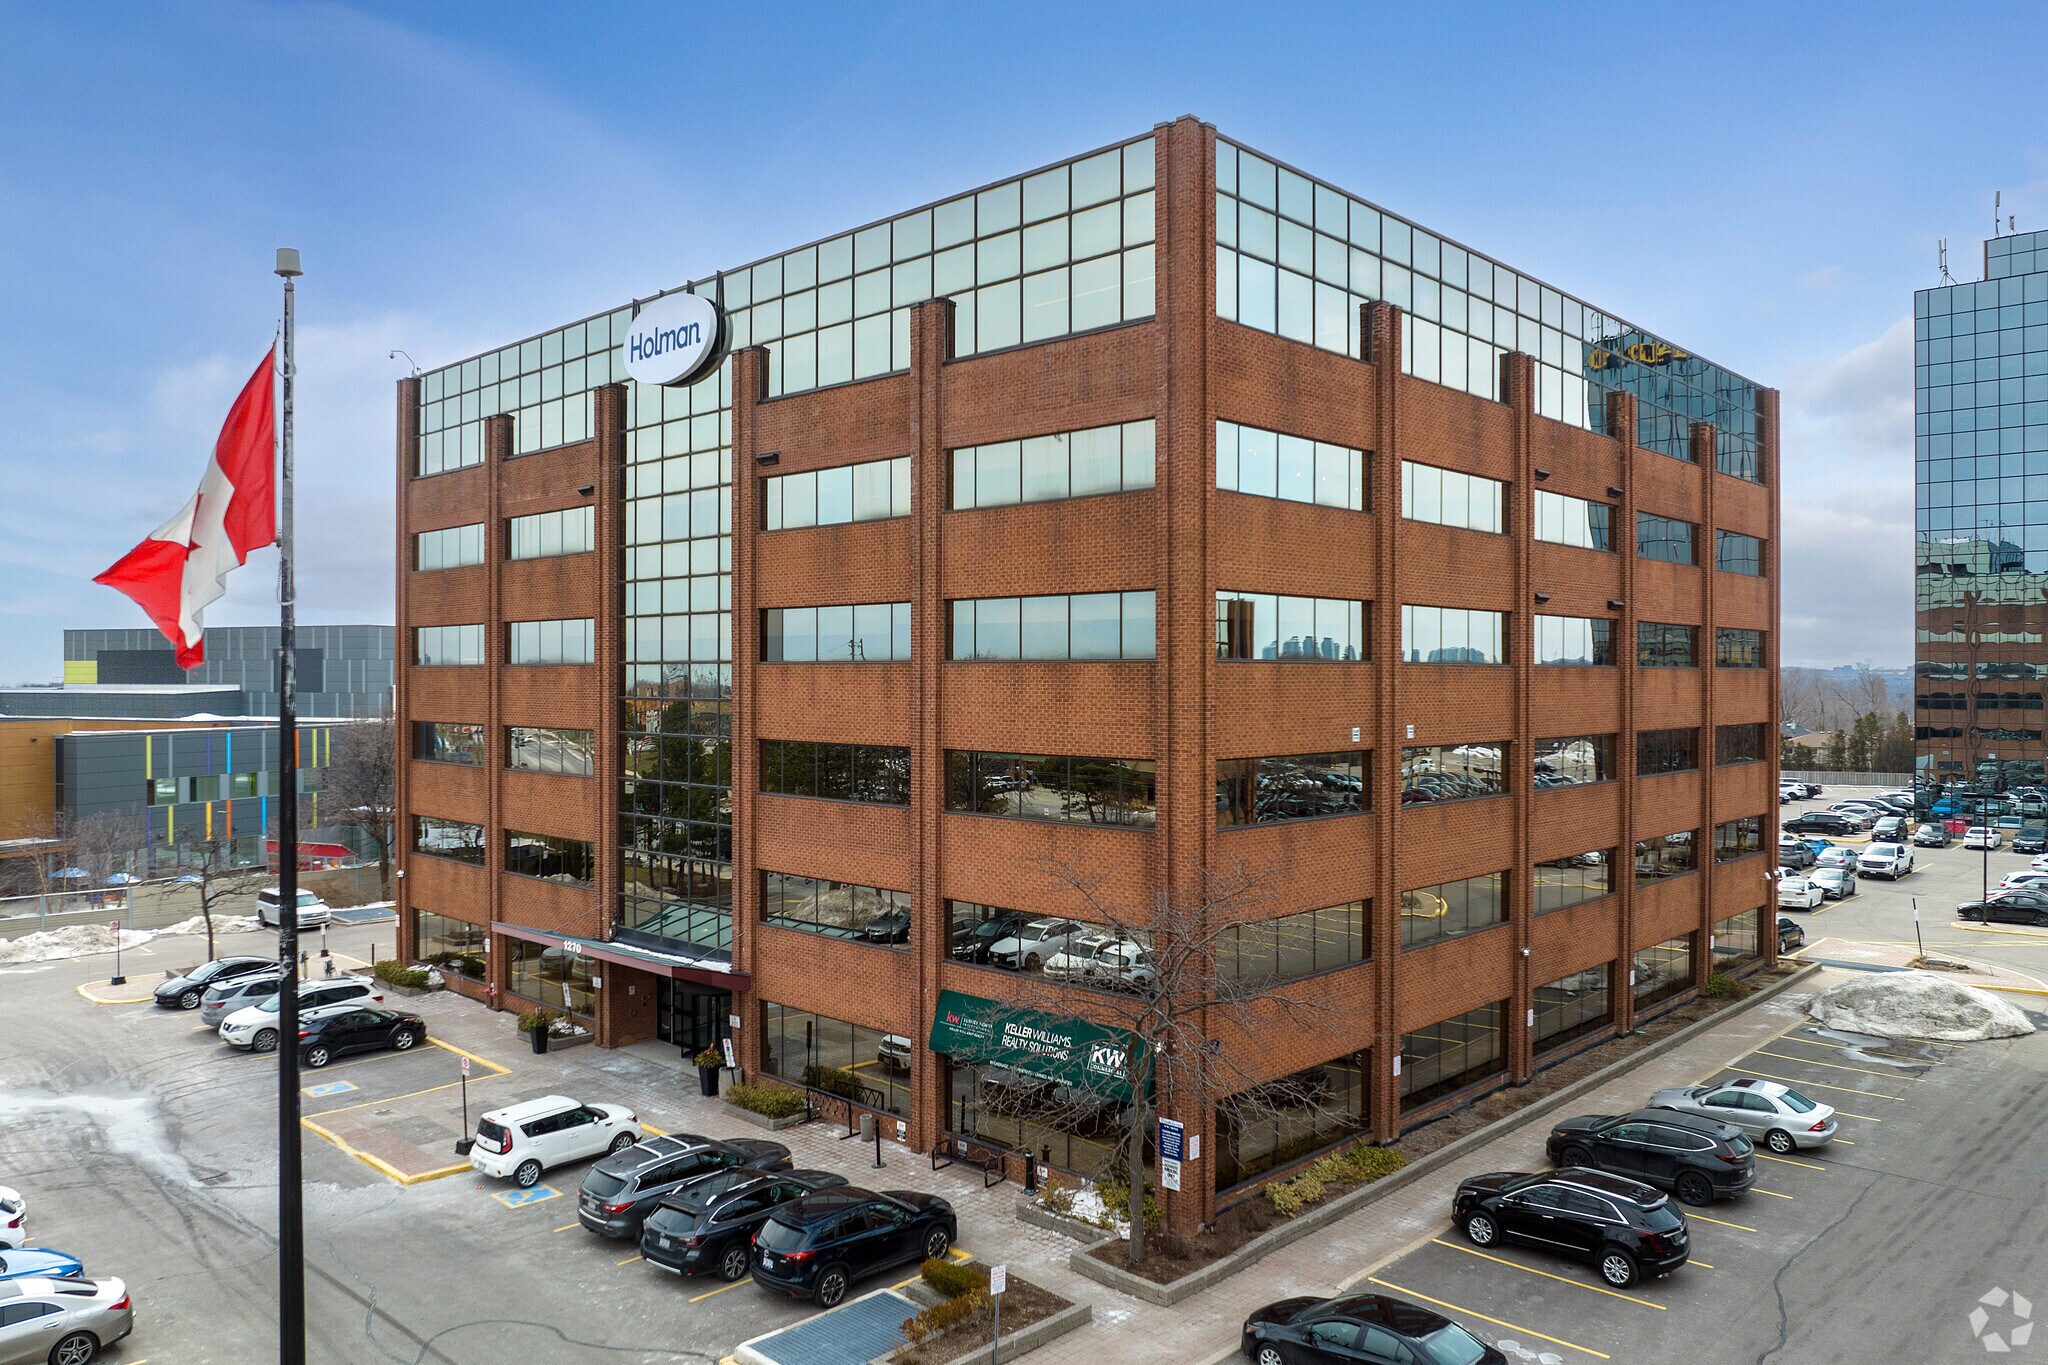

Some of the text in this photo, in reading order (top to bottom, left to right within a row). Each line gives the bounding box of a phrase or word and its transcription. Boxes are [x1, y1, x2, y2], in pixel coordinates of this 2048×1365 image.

[630, 321, 701, 363] Holman
[563, 940, 582, 953] 1270
[1001, 1034, 1029, 1051] REALTY
[1004, 1022, 1033, 1040] KELLER
[1033, 1028, 1072, 1048] WILLIAMS
[1091, 1045, 1126, 1068] KW
[1090, 1064, 1122, 1076] COMMERCAL
